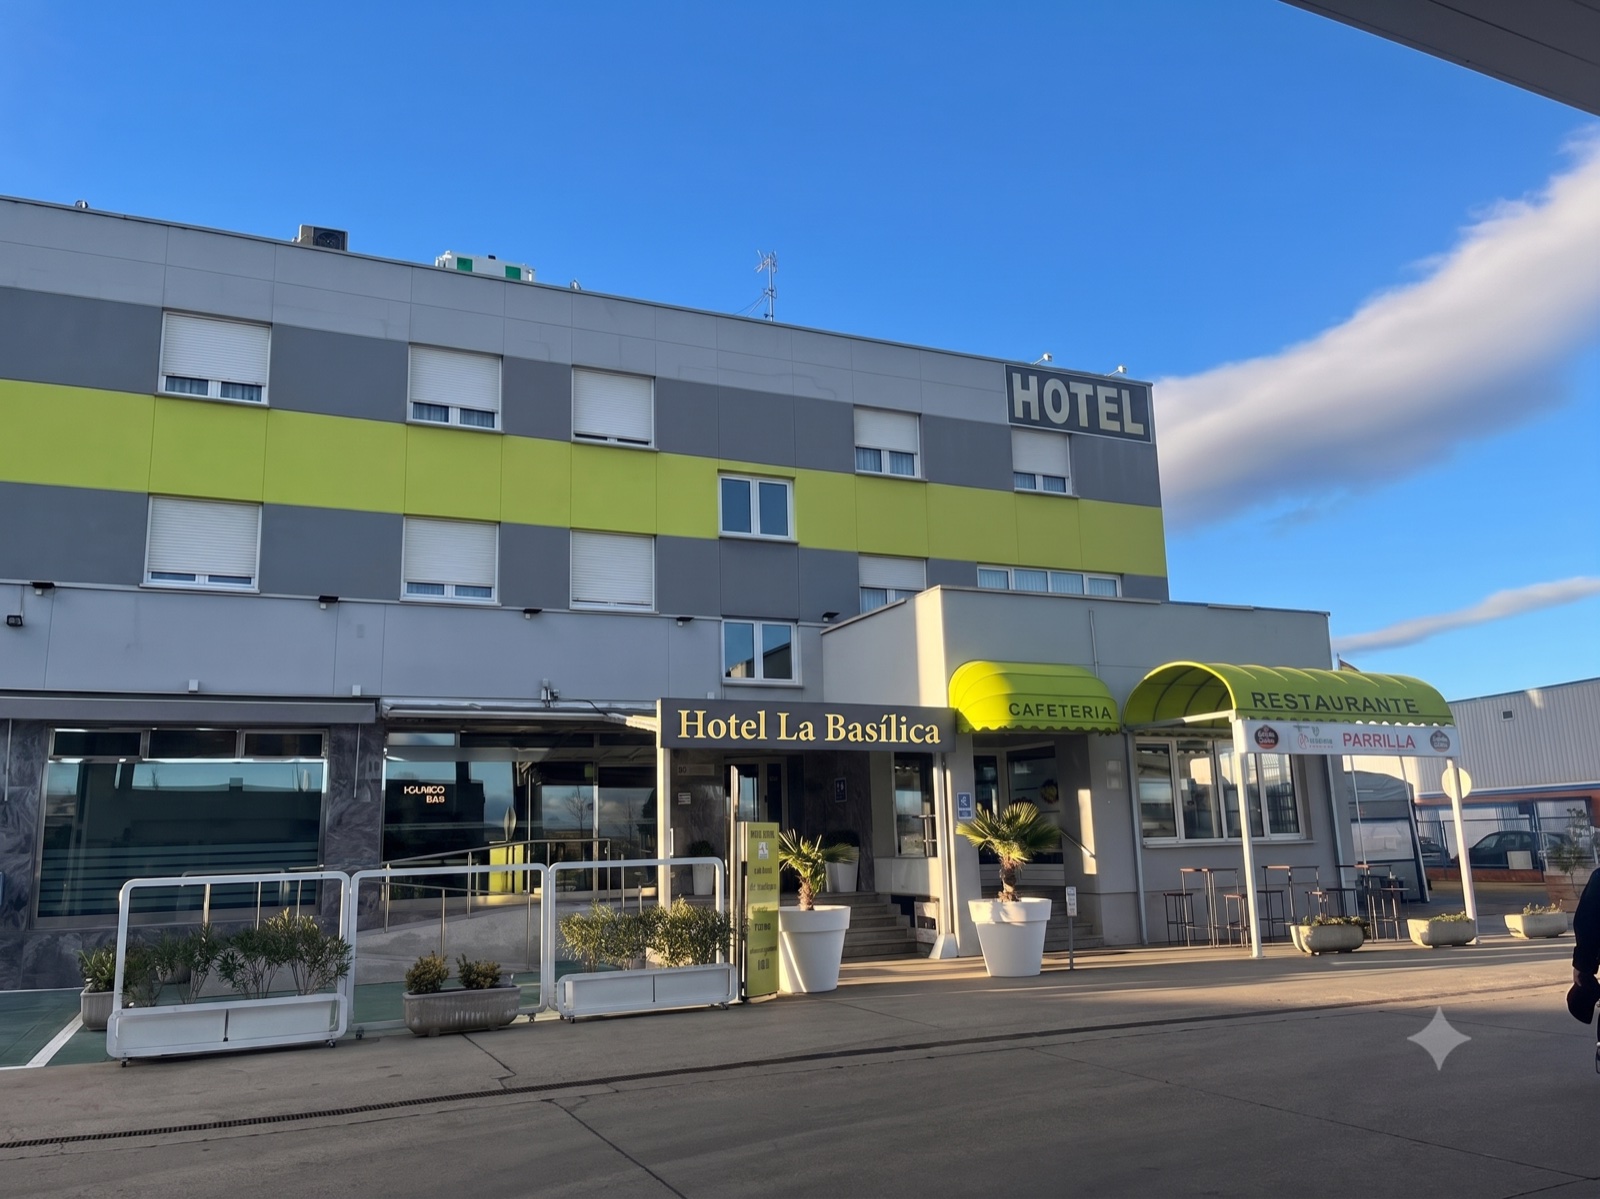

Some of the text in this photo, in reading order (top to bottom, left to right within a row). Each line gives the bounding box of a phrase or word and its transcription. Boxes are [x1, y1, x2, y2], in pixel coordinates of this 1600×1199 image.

[1011, 372, 1145, 436] HOTEL
[1008, 702, 1112, 720] CAFETERIA
[1250, 691, 1420, 714] RESTAURANTE
[677, 709, 942, 745] Hotel La Basílica
[1342, 732, 1416, 749] PARRILLA
